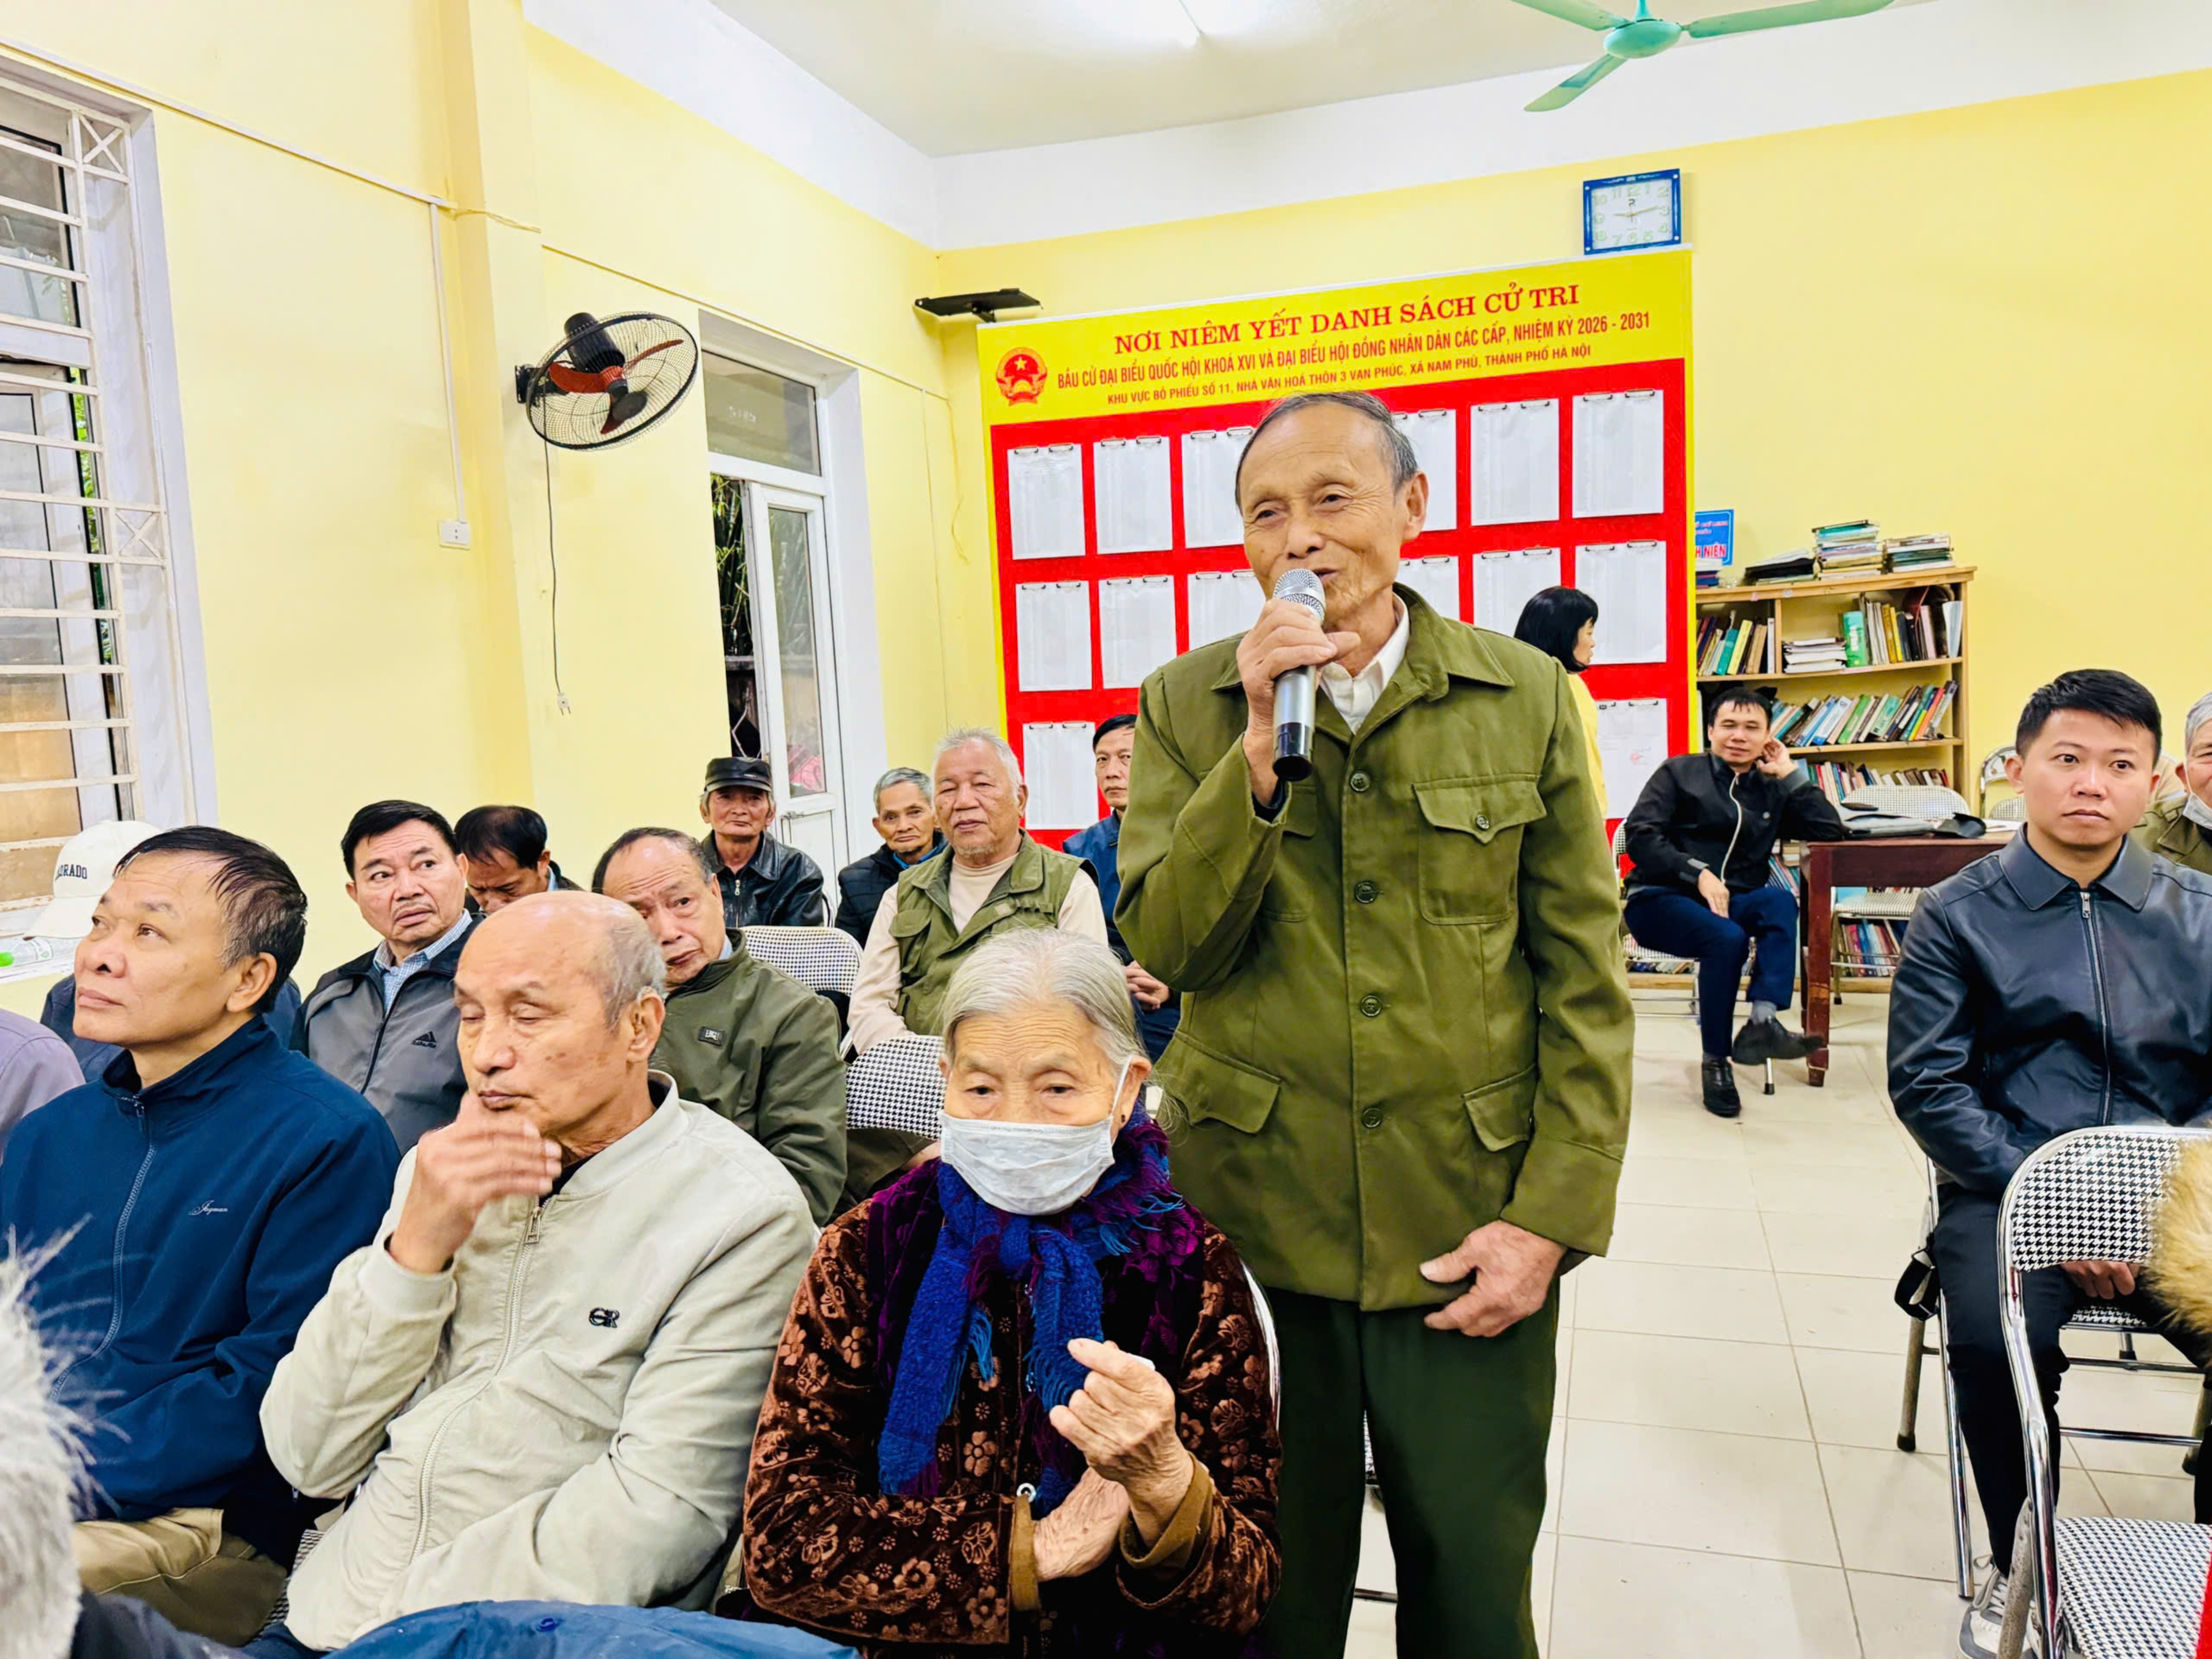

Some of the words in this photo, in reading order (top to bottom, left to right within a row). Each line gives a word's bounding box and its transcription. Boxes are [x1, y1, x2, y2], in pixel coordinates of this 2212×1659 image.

[1100, 368, 1118, 388] ĐẠI
[1149, 357, 1178, 381] QUỐC
[1182, 356, 1200, 380] HỘI
[1237, 353, 1255, 371] XVI
[1259, 349, 1274, 369] VÀ
[1277, 349, 1296, 370] ĐẠI
[1300, 340, 1326, 364] BIỂU
[1329, 340, 1349, 364] HỘI
[1390, 332, 1422, 355] NHÂN
[1427, 330, 1451, 351] DÂN
[1455, 326, 1479, 348] CÁC
[1514, 318, 1553, 343] NHIỆM
[1577, 316, 1608, 335] 2026
[1620, 311, 1650, 330] 2031
[1115, 330, 1161, 354] NƠI
[1170, 320, 1241, 348] NIÊM
[1249, 308, 1302, 340] YẾT
[1310, 306, 1392, 334] DANH
[1400, 295, 1476, 324] SÁCH
[1484, 282, 1524, 313] CỬ
[1529, 285, 1580, 309] TRI
[1108, 394, 1127, 405] KHU
[1341, 372, 1347, 382] 3
[1427, 359, 1451, 372] NAM
